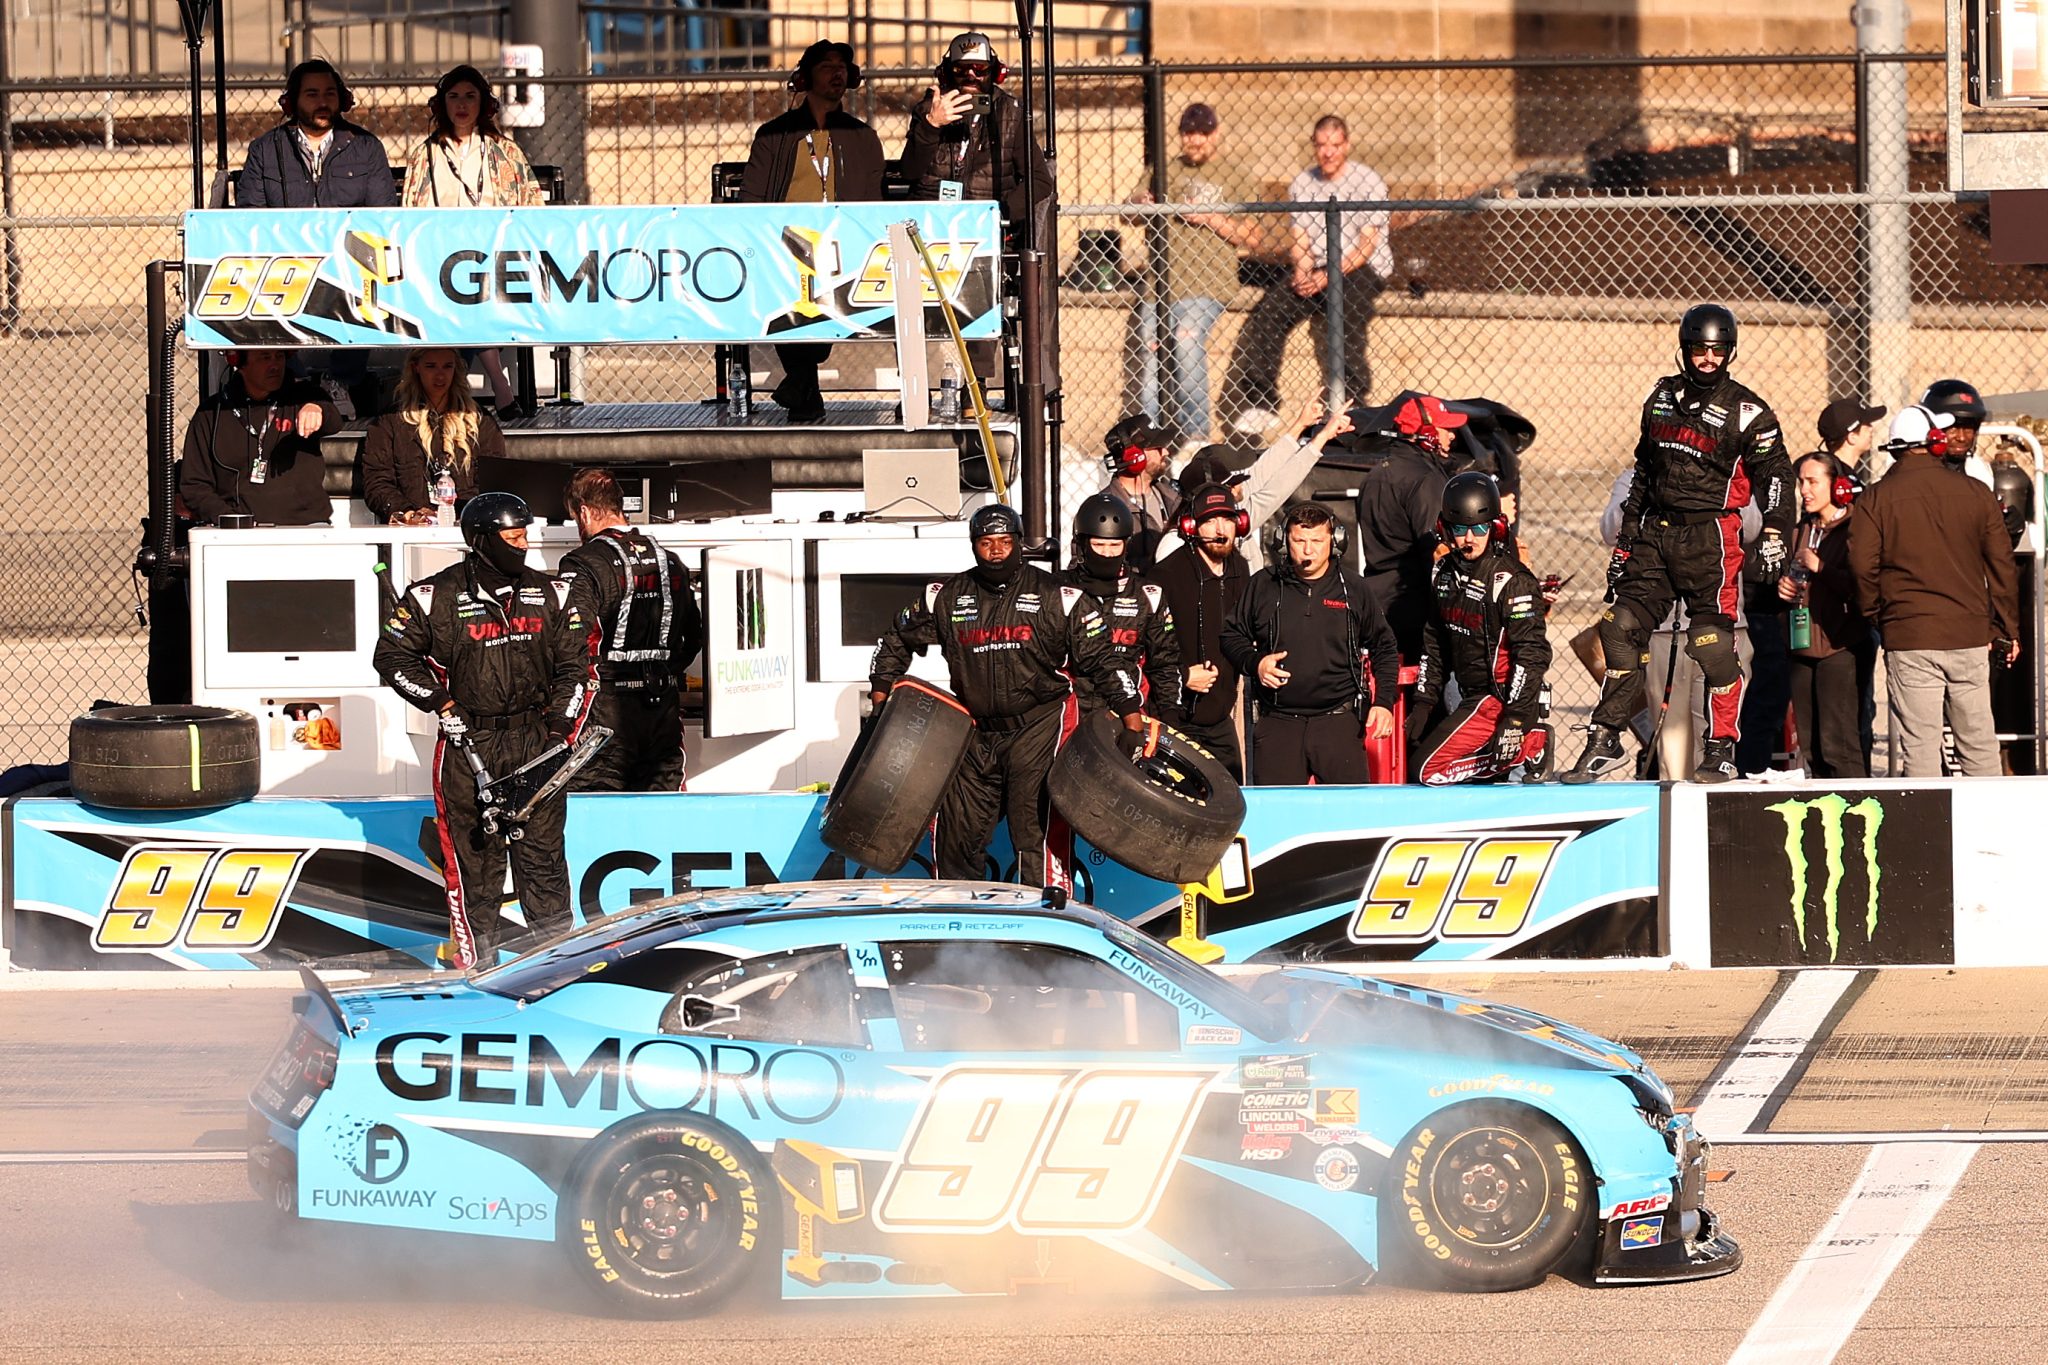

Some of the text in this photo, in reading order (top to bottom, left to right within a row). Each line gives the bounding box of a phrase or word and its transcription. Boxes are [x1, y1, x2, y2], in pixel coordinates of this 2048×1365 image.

[197, 254, 325, 319] 99
[394, 670, 433, 698] VIKING
[717, 654, 790, 684] FUNKAWAY
[93, 844, 312, 951] 99
[1350, 833, 1575, 941] 99
[448, 890, 472, 966] VIKING
[900, 923, 946, 931] PARKER
[965, 923, 1024, 931] RETZLAFF
[1183, 892, 1194, 941] GEMORO
[1109, 948, 1214, 1020] FUNKAWAY
[1243, 1091, 1309, 1107] COMETIC
[1428, 1074, 1554, 1098] GOODYEAR
[1242, 1111, 1294, 1122] LINCOLN
[1253, 1123, 1300, 1131] WELDERS
[874, 1063, 1224, 1233] 99
[1240, 1149, 1285, 1160] MSD
[681, 1131, 759, 1252] GOODYEAR
[1554, 1142, 1580, 1212] EAGLE
[312, 1189, 437, 1209] FUNKAWAY
[1402, 1128, 1451, 1260] GOODYEAR
[1611, 1194, 1669, 1218] ARP
[449, 1196, 548, 1227] SciAps
[1623, 1225, 1661, 1239] SUNOCO
[581, 1218, 620, 1283] EAGLE
